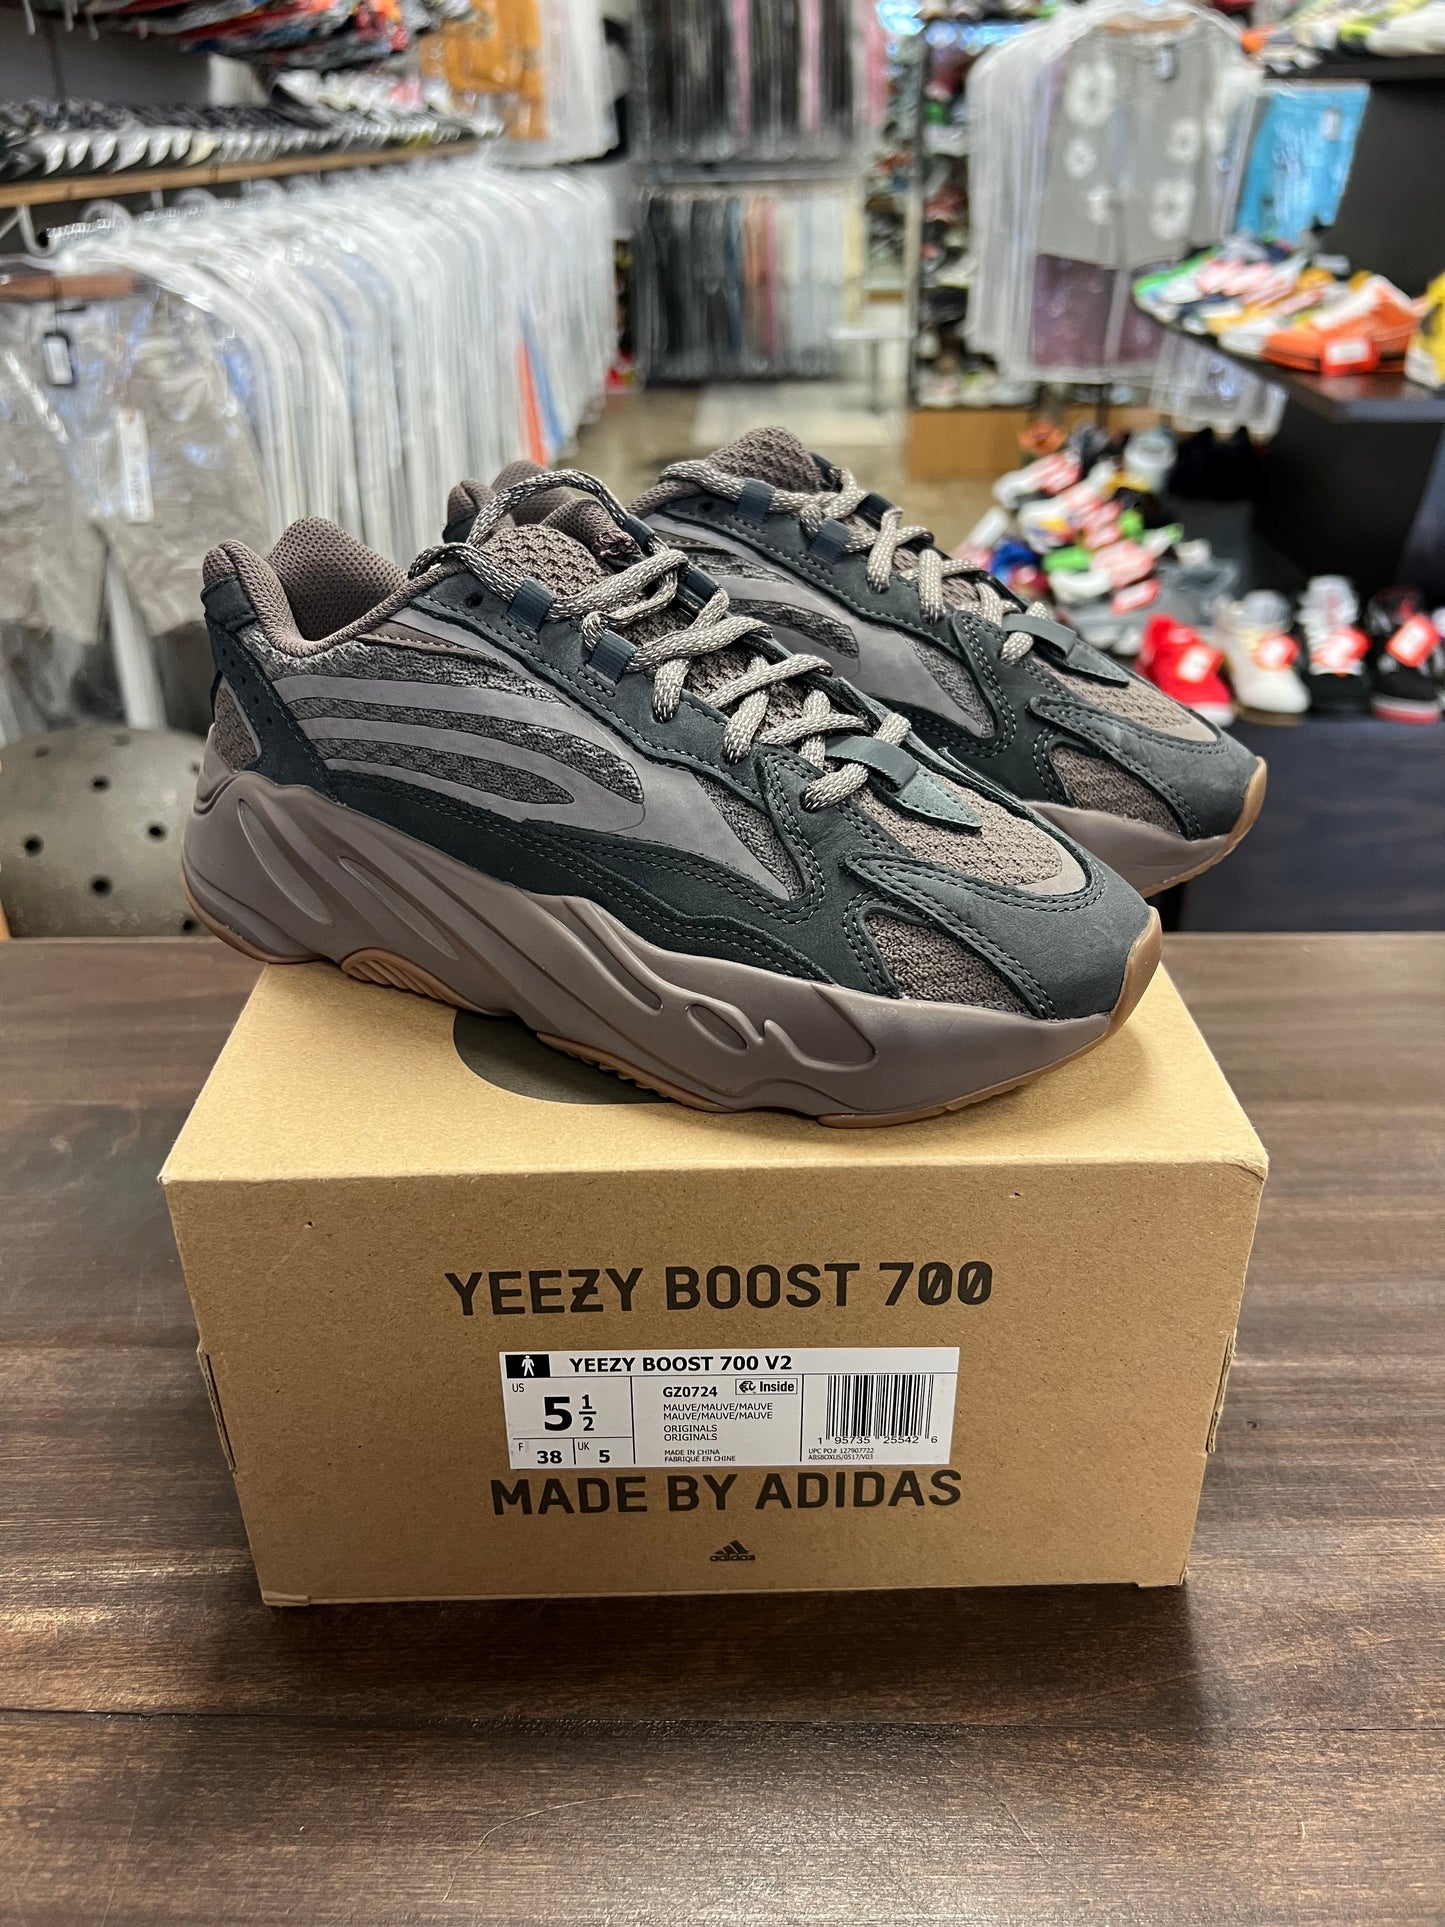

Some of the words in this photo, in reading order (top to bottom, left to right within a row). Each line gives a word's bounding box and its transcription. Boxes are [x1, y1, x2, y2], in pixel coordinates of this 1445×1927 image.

[444, 1268, 643, 1316] YEEZY
[666, 1263, 860, 1311] BOOST
[879, 1261, 993, 1307] 700
[569, 1357, 635, 1373] YEEZY
[642, 1356, 713, 1372] BOOST
[720, 1356, 759, 1371] 700
[765, 1355, 792, 1370] V2
[511, 1382, 525, 1393] US
[759, 1380, 795, 1393] Inside
[662, 1386, 718, 1398] GZ0724
[663, 1402, 773, 1412] MAUVE/MAUVE/MAUVE
[543, 1396, 573, 1432] 5
[663, 1411, 773, 1421] MAUVE/MAUVE/MAUVE
[663, 1424, 718, 1433] ORIGINALS
[663, 1433, 718, 1442] ORIGINALS
[817, 1437, 823, 1445] 1
[834, 1436, 871, 1445] 95735
[882, 1435, 919, 1444] 25542
[930, 1435, 938, 1444] 6
[518, 1442, 524, 1452] F
[577, 1441, 590, 1451] UK
[536, 1450, 563, 1465] 38
[598, 1449, 611, 1464] 5
[664, 1455, 700, 1463] FABRIQUÉ
[490, 1476, 648, 1516] MADE
[667, 1473, 738, 1512] BY
[755, 1469, 962, 1509] ADIDAS
[709, 1553, 756, 1562] adidas
